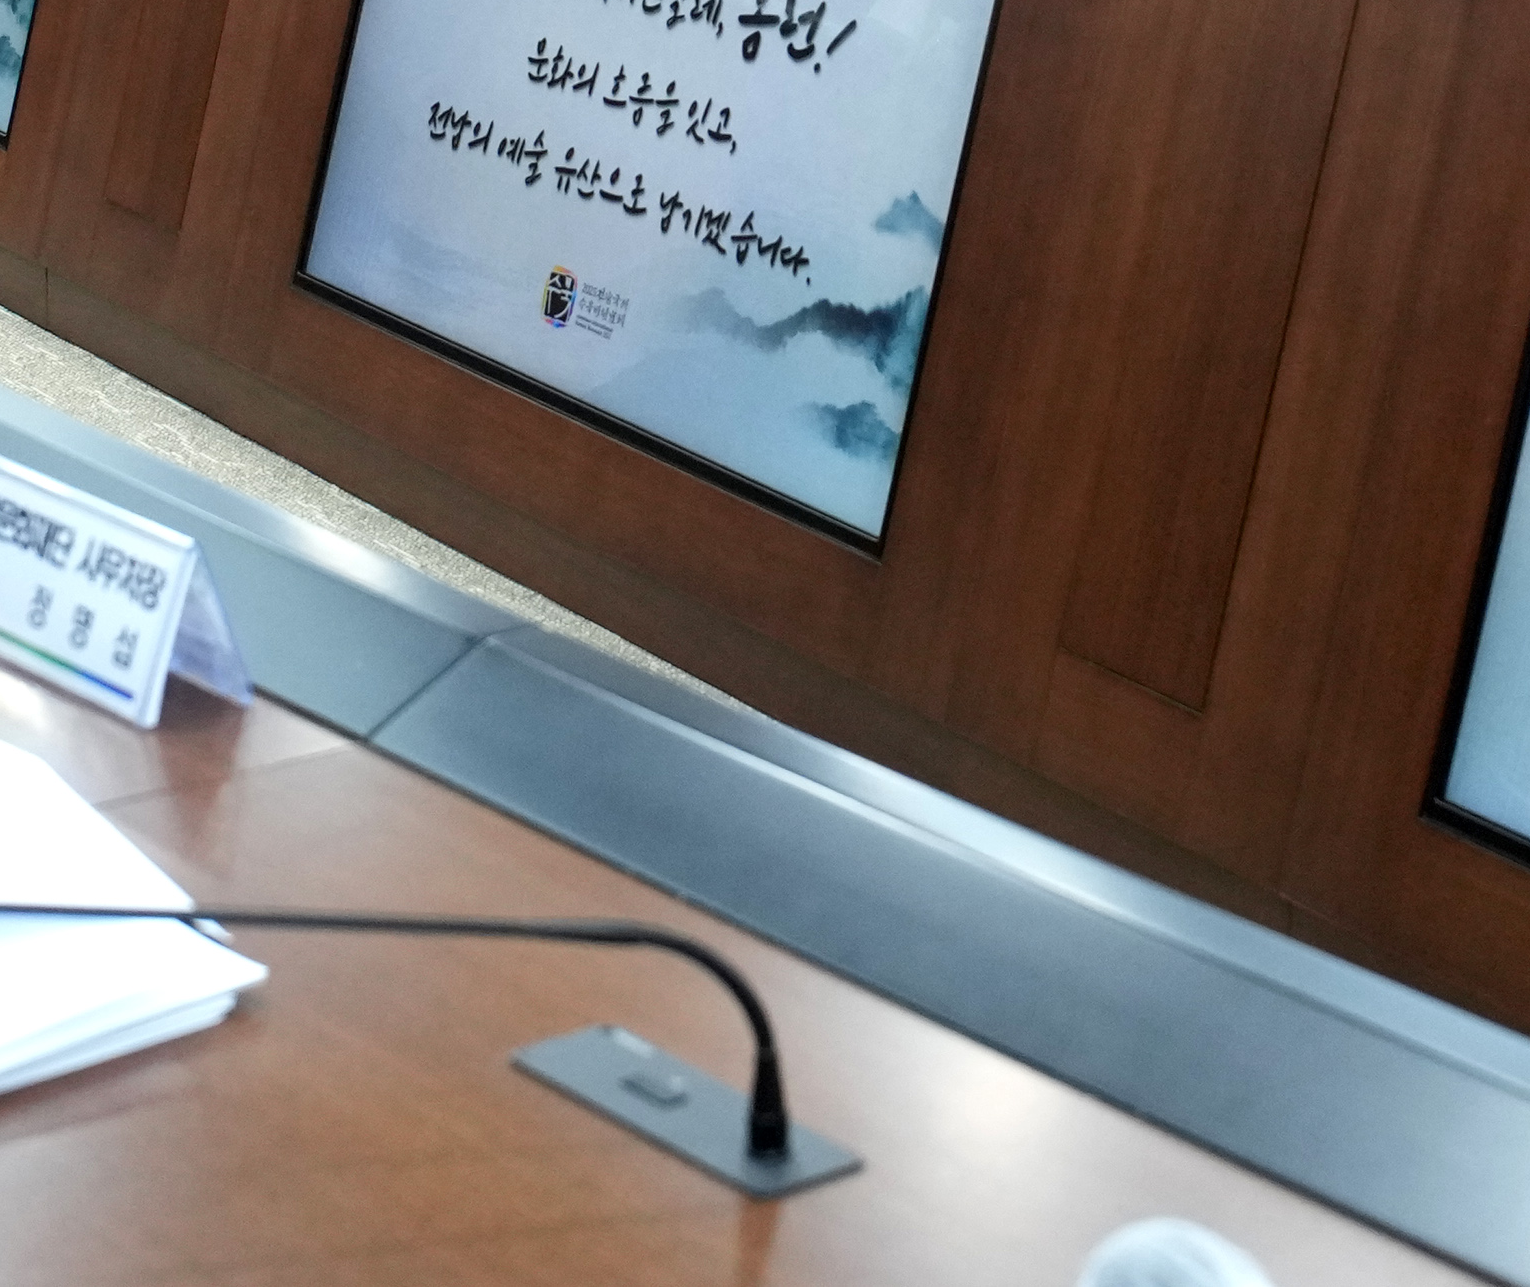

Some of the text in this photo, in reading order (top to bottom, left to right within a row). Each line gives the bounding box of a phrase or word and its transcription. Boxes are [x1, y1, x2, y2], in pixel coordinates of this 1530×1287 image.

[526, 36, 737, 155] 문화의 흐름을 잇고,
[427, 100, 494, 154] 전남의
[496, 128, 548, 187] 예술
[553, 146, 647, 217] 유산으로
